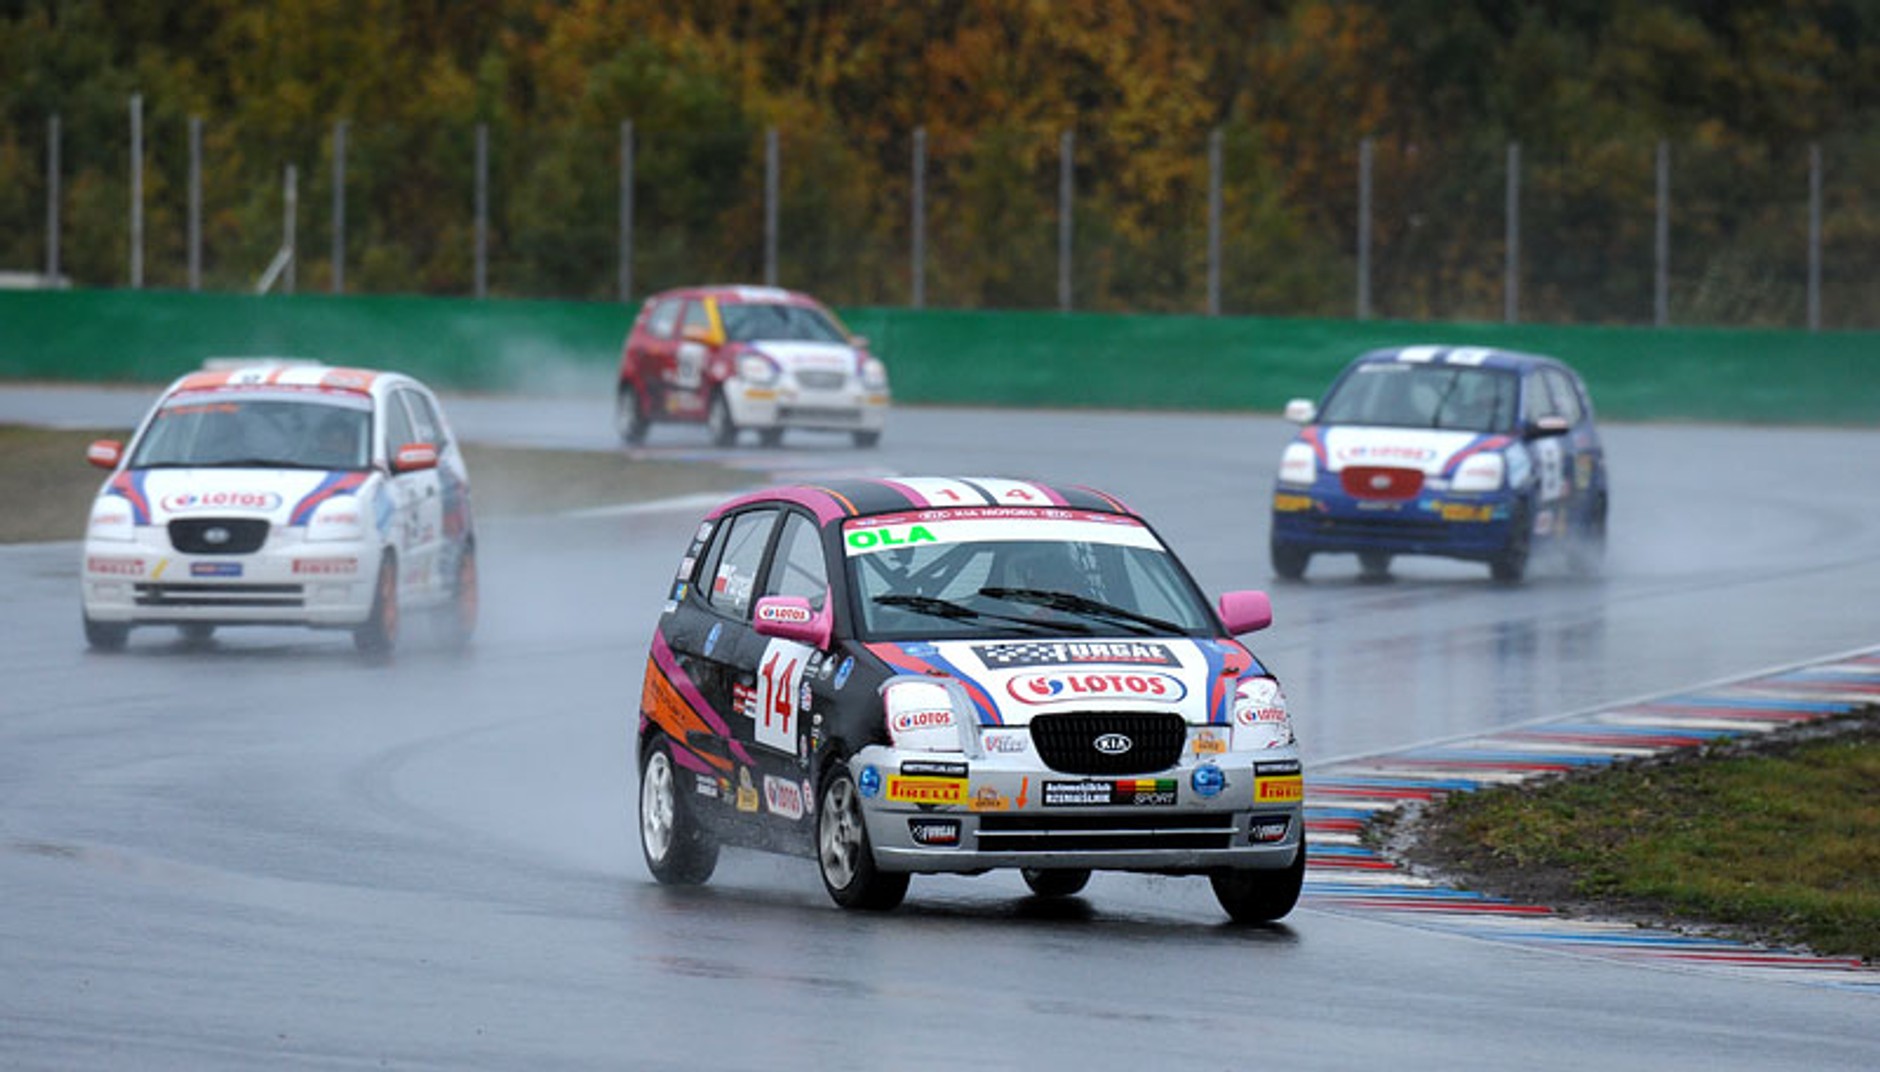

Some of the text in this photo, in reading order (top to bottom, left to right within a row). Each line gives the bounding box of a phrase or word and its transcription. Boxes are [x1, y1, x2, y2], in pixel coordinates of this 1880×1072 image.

[202, 492, 266, 507] LOTOS
[935, 488, 1034, 501] 1 4
[848, 525, 937, 549] OLA
[292, 557, 358, 575] PIRELLI
[775, 608, 806, 620] LOTOS
[761, 650, 798, 735] 14
[1067, 675, 1167, 695] LOTOS
[913, 712, 950, 726] LOTOS
[891, 780, 961, 800] PIRELLI
[1134, 792, 1174, 805] SPORT
